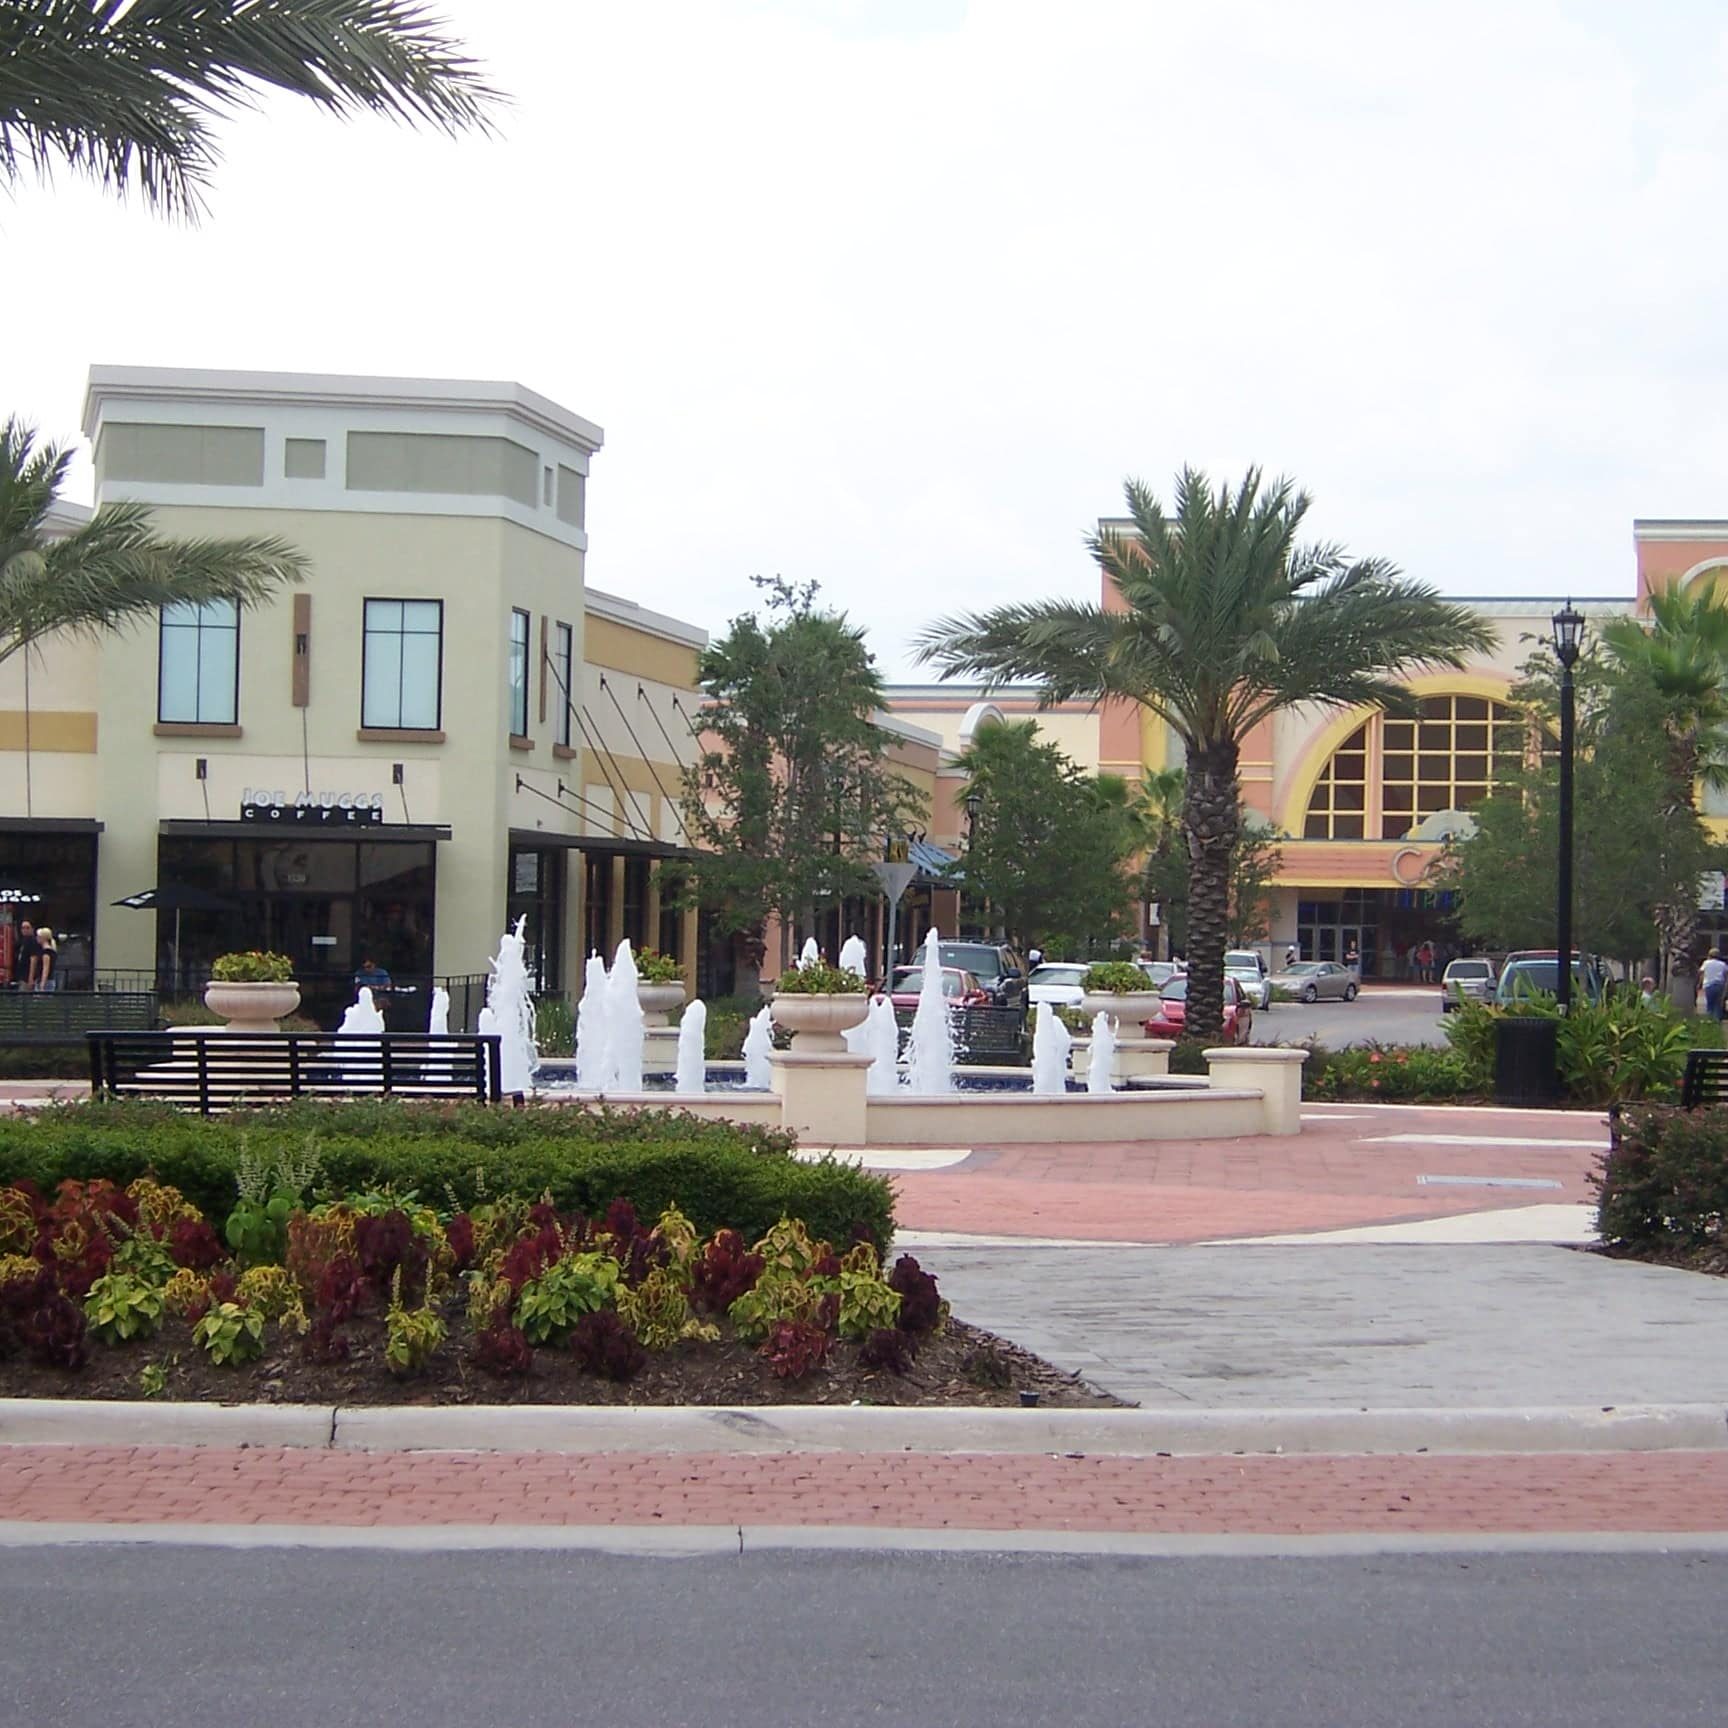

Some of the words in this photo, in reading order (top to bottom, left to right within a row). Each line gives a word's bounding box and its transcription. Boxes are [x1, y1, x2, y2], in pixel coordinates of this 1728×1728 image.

[243, 788, 285, 808] JOE
[295, 791, 383, 809] MUGGS
[245, 809, 380, 821] COFFEE
